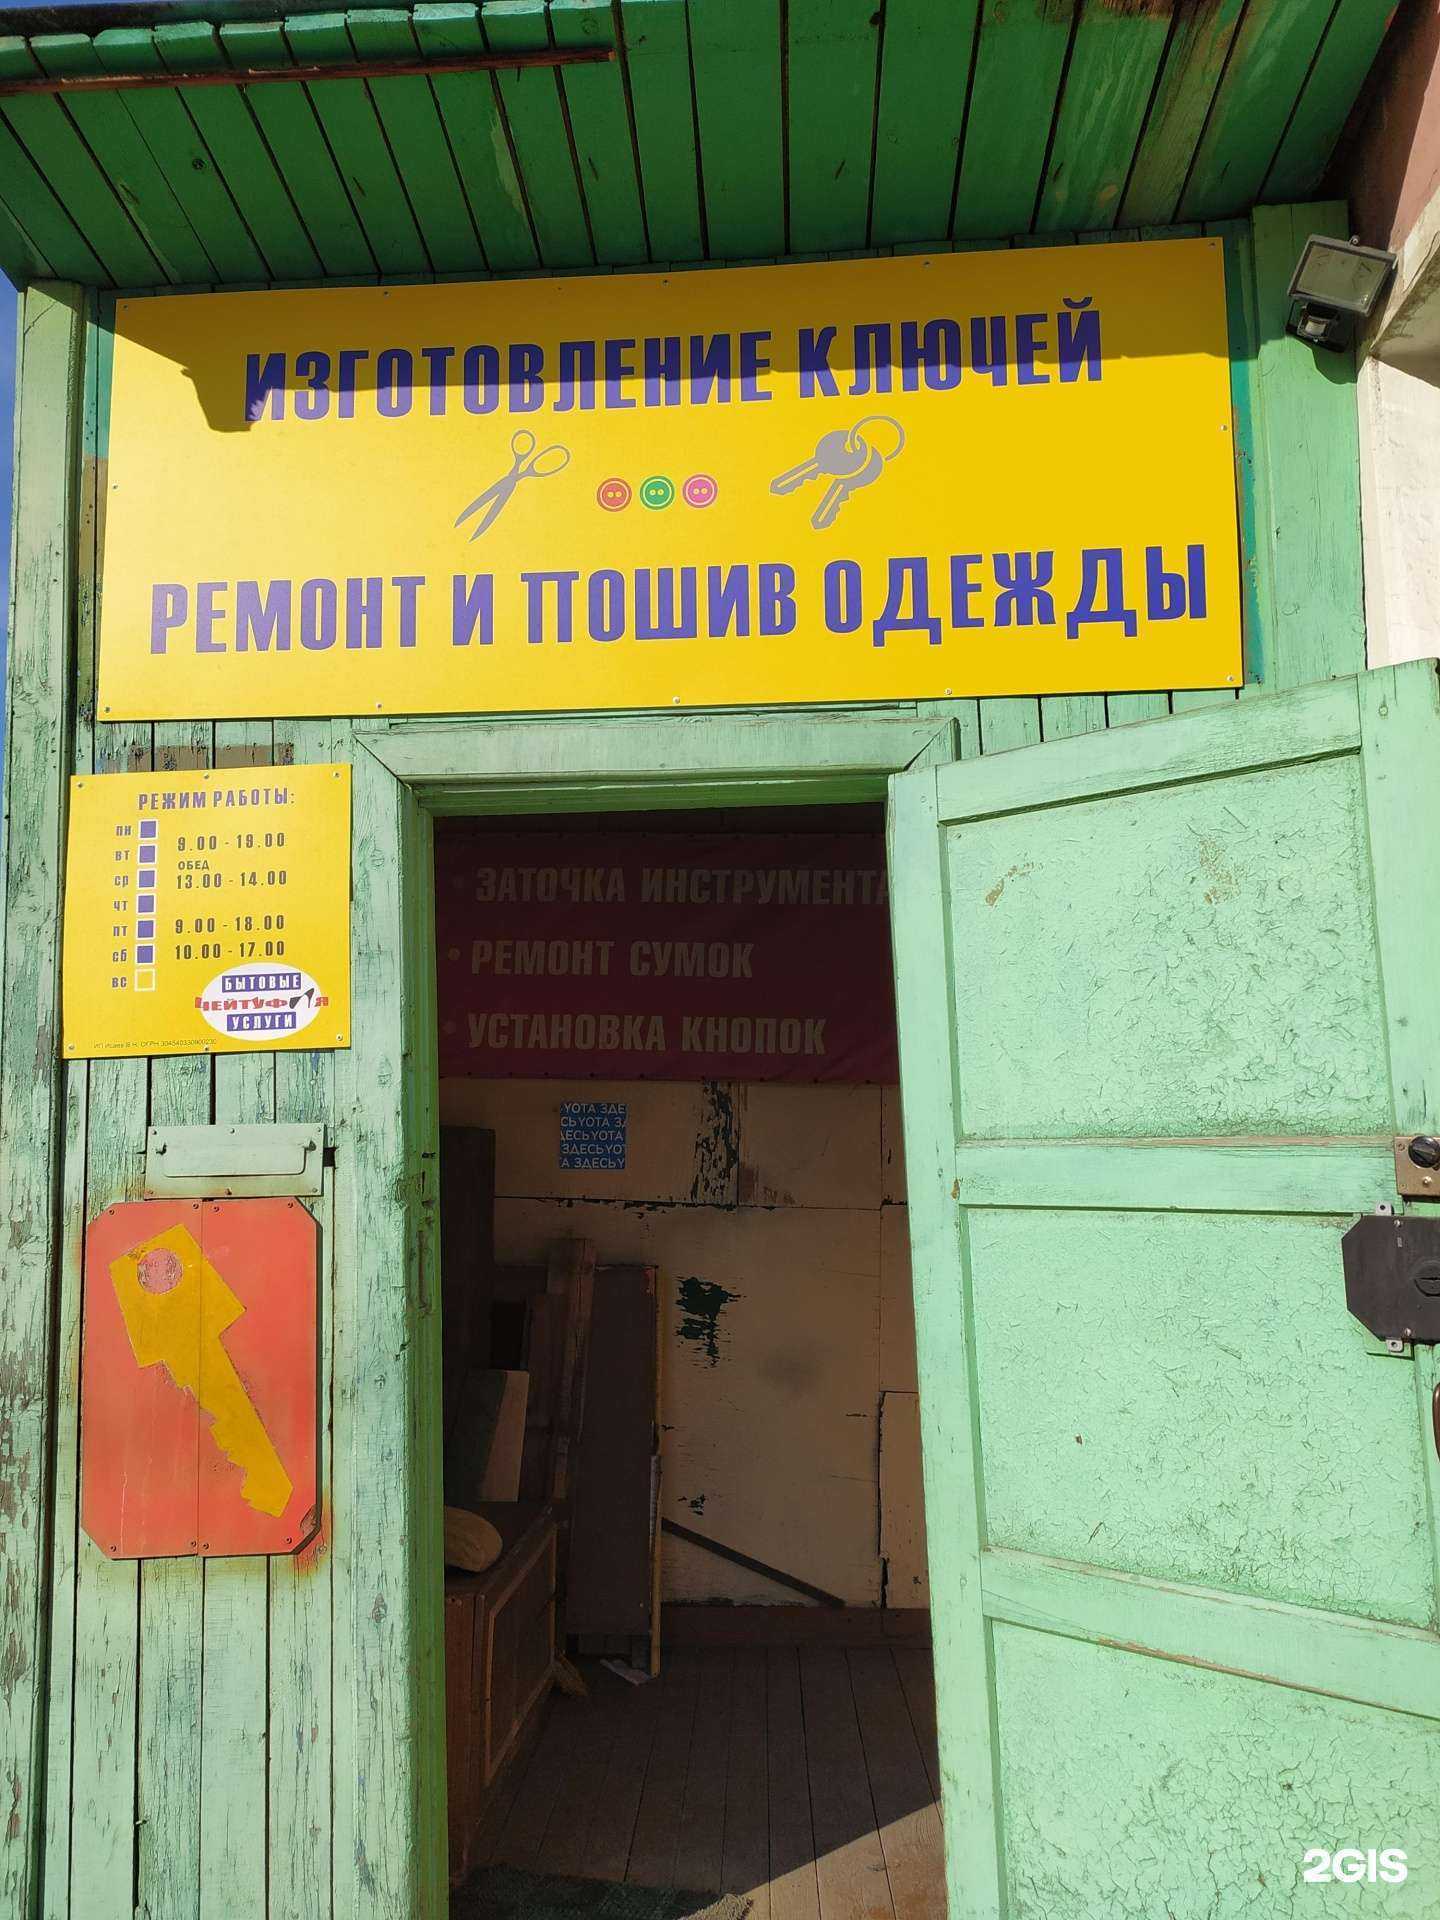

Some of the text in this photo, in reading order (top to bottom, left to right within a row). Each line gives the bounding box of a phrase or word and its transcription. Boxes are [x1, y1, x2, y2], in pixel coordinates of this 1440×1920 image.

[244, 295, 1102, 422] ИЗГОТОВЛЕНИЕ КЛЮЧЕЙ
[150, 543, 1208, 655] РЕМОНТ И ПОШИВ ОДЕЖДЫ
[138, 787, 296, 811] РЕЖИМ РАБОТЫ:
[177, 836, 217, 852] 9.00
[177, 860, 210, 872] ОБЕД
[176, 873, 222, 890] 13.00
[240, 870, 287, 888] 14.00
[475, 866, 626, 903] ЗАТОЧКА
[175, 918, 216, 935] 9.00
[235, 914, 285, 932] 18.00
[175, 943, 221, 960] 10.00
[239, 941, 285, 958] 17.00
[470, 939, 755, 979] РЕМОНТ СУМОК
[223, 973, 300, 992] БЫТОВЫЕ
[231, 1014, 293, 1031] УСЛУГИ
[467, 1013, 828, 1056] УСТАНОВКА КНОПОК
